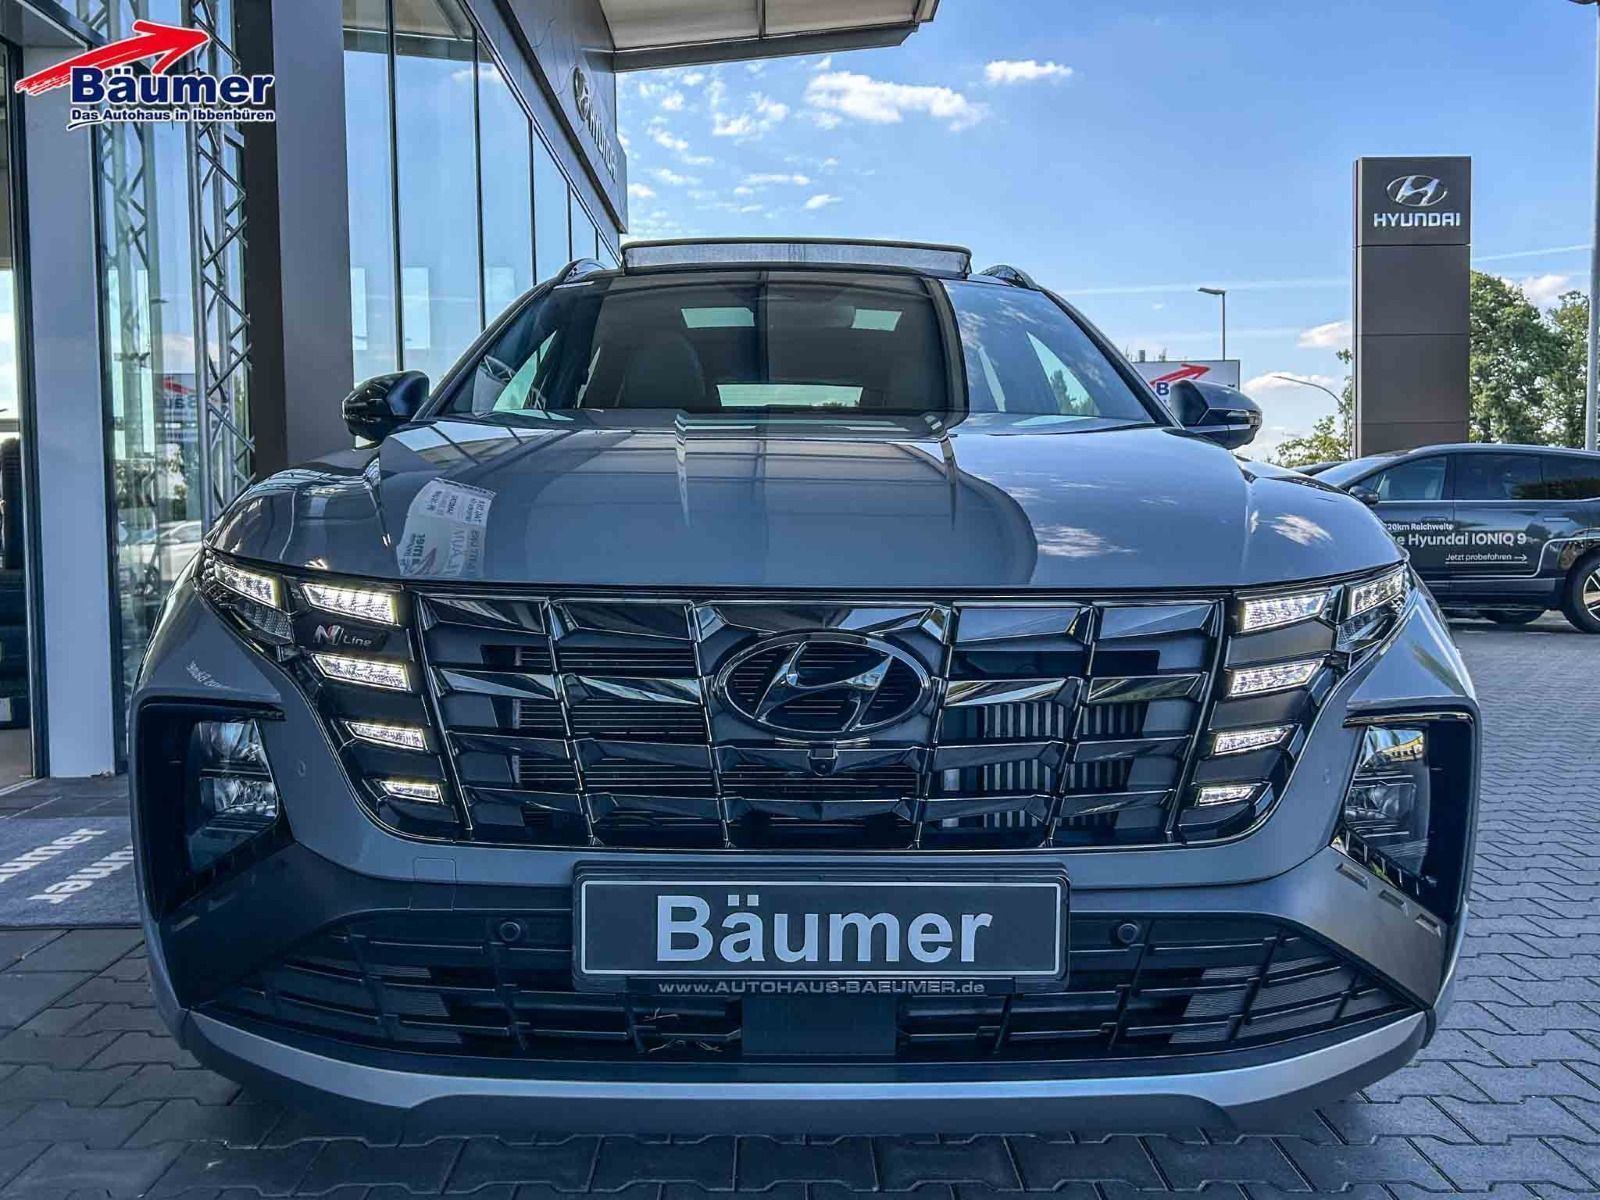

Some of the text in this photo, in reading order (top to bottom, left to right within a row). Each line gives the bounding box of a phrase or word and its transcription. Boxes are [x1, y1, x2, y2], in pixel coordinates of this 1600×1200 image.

[1373, 212, 1461, 228] HYUNDAI
[1385, 522, 1455, 531] 20km Reichweite
[1408, 532, 1469, 548] Hyundai
[1472, 533, 1514, 546] IONIQ
[1517, 533, 1527, 545] 9
[1445, 553, 1512, 562] Jetzt probefahren
[343, 635, 372, 647] Line
[656, 894, 994, 963] Bäumer
[658, 980, 986, 994] www.AUTOHAUS-BAEUMER.de
